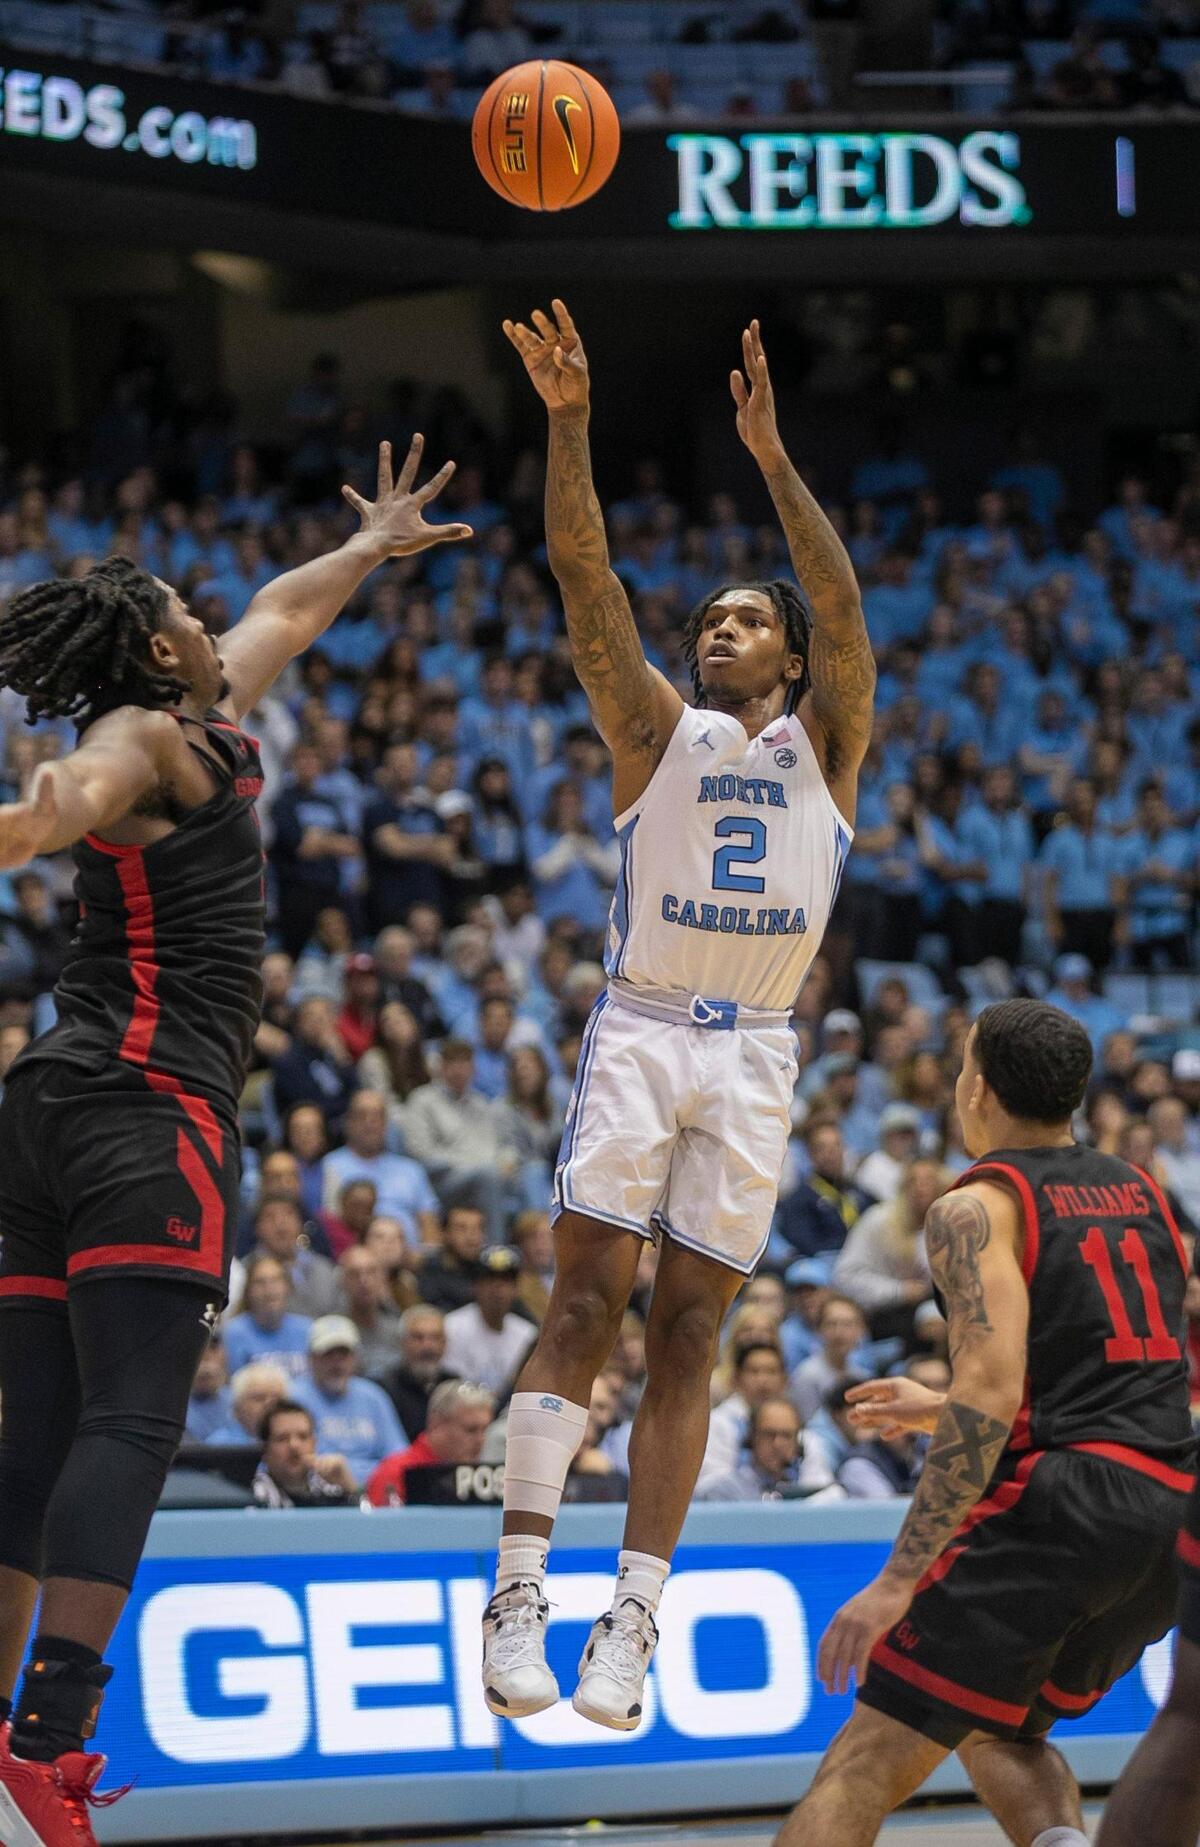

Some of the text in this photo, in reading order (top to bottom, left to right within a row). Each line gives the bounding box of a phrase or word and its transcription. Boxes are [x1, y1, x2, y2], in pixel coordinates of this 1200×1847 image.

[0, 66, 258, 170] EDS.com
[503, 94, 528, 173] ELITE
[665, 131, 1033, 229] REEDS
[697, 774, 788, 808] NORTH
[712, 816, 767, 893] 2
[661, 894, 807, 935] CAROLINA
[166, 1217, 195, 1242] GW
[1043, 1182, 1150, 1217] WILLIAMS
[1079, 1227, 1181, 1362] 11
